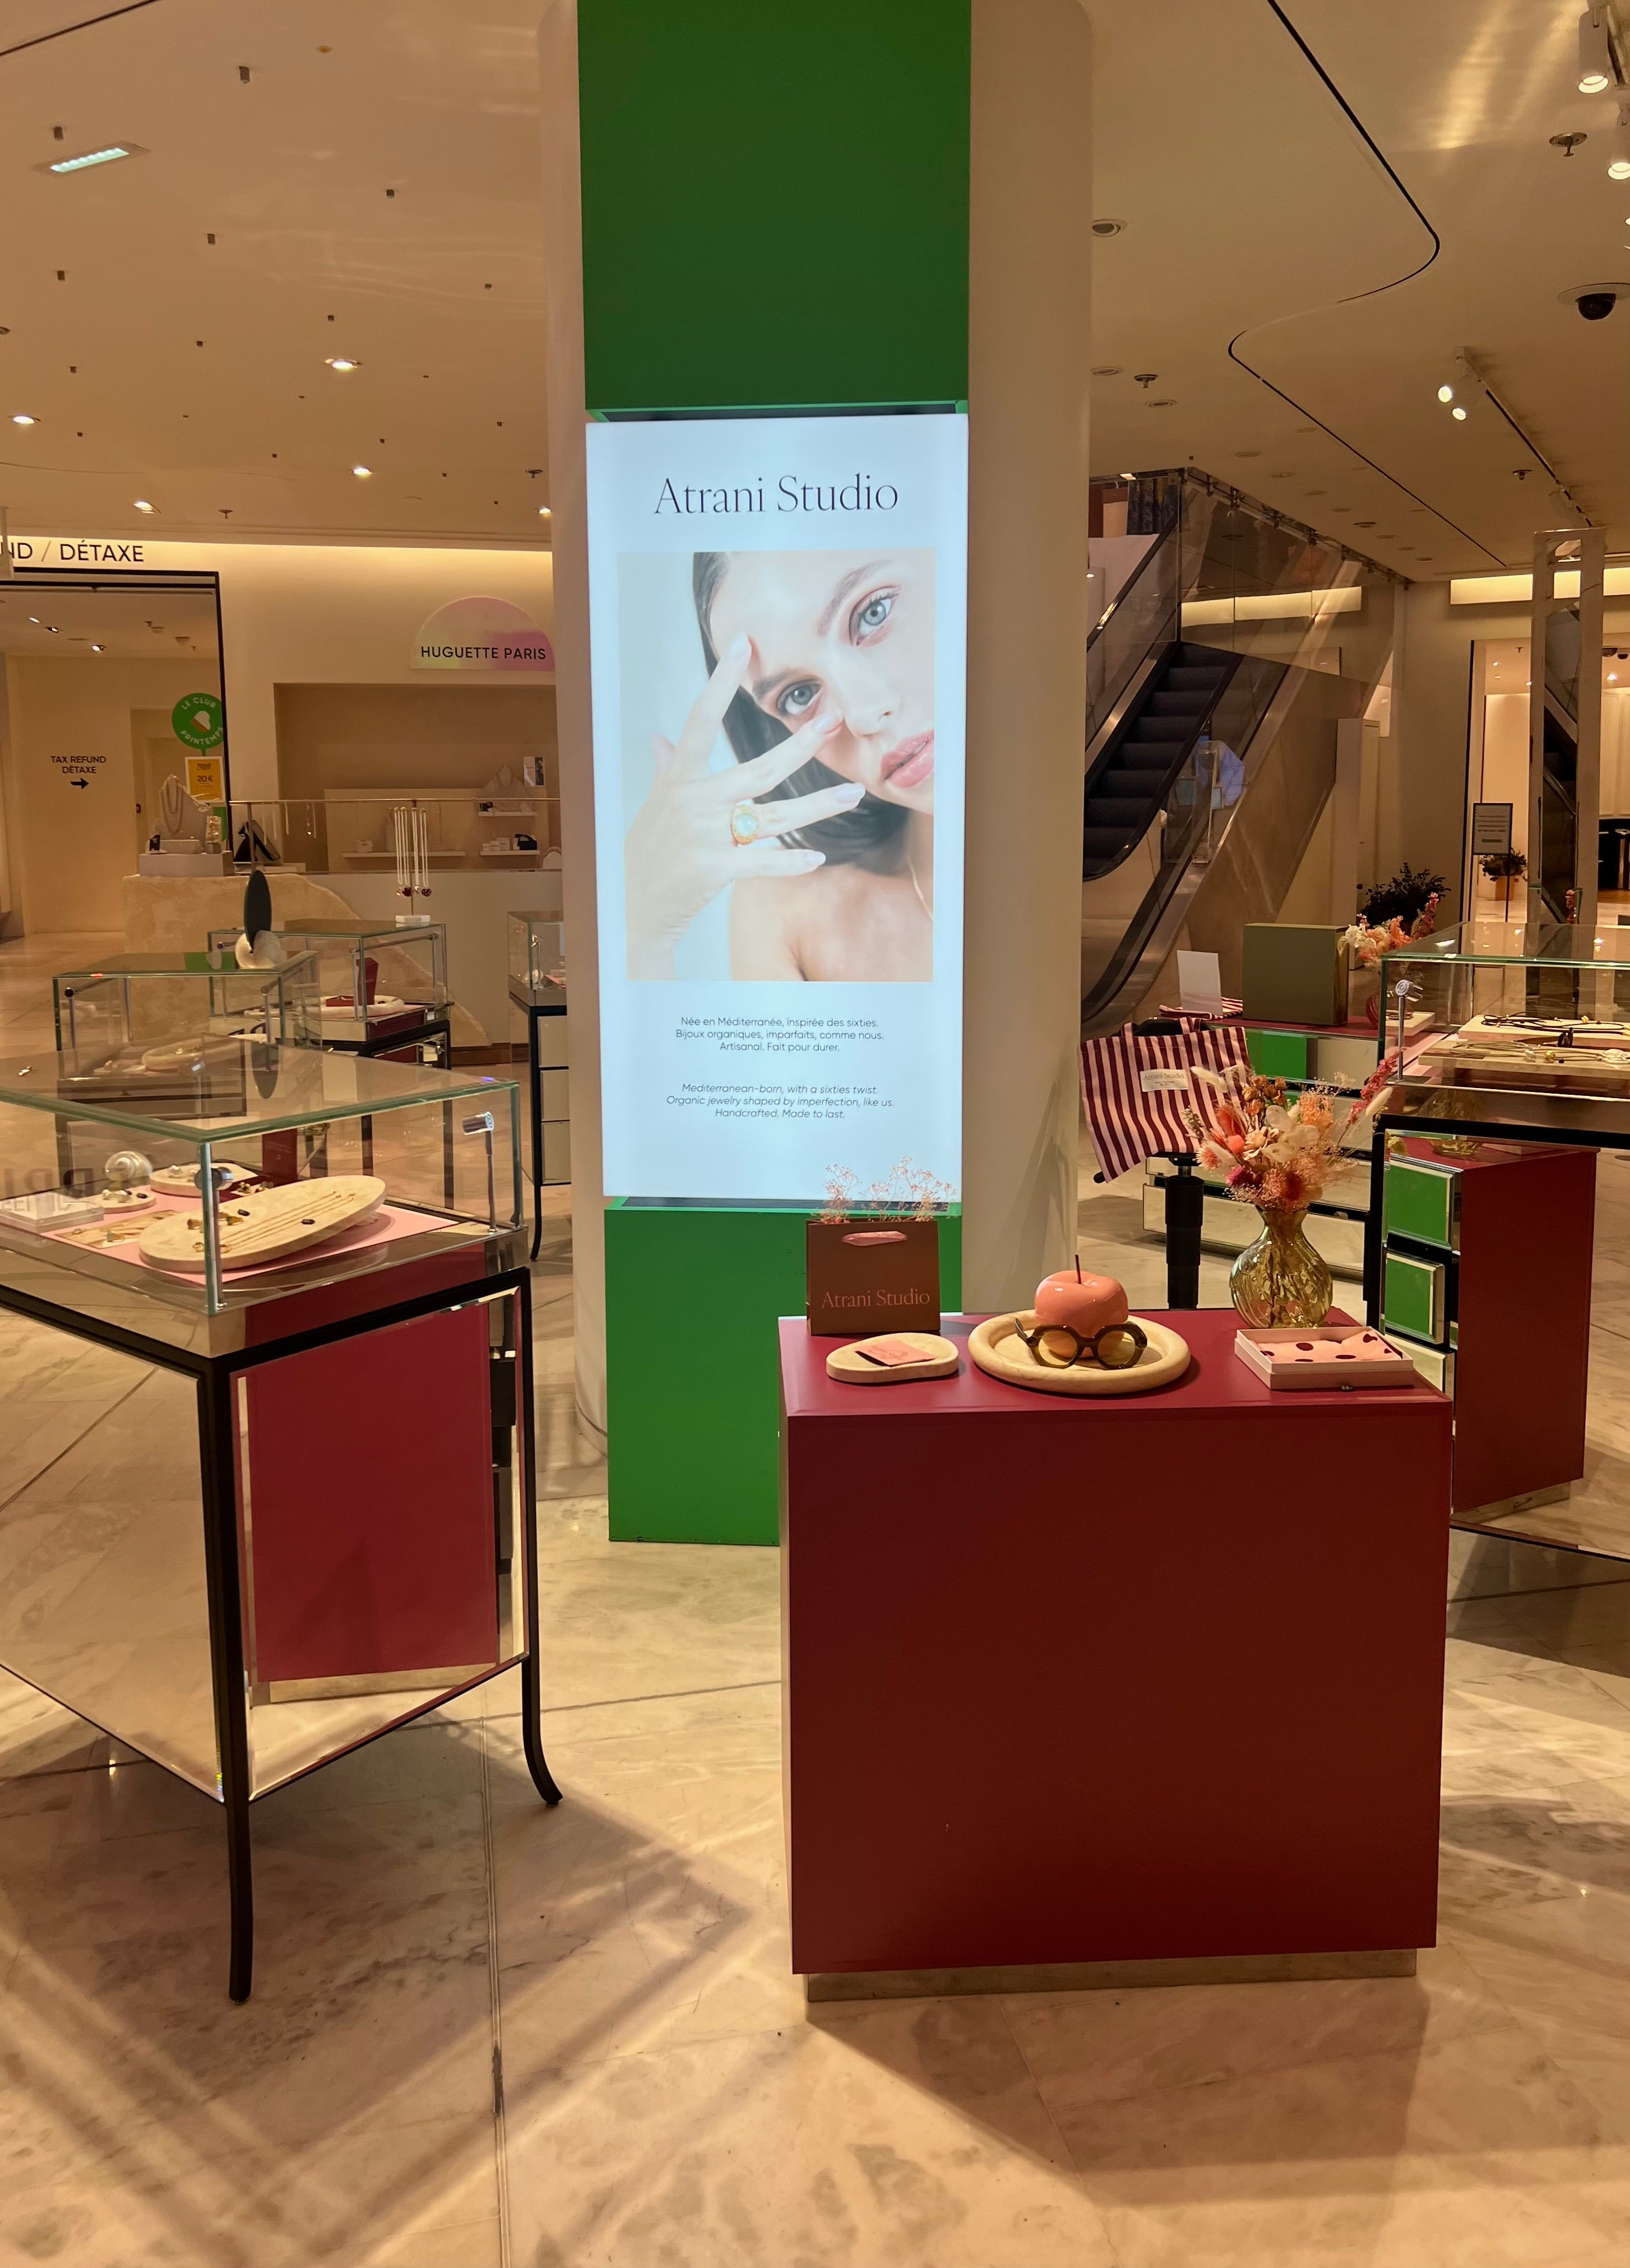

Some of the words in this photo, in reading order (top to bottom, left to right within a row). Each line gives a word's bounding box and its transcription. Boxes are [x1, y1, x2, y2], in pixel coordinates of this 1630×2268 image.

[654, 476, 766, 515] Atrani
[777, 473, 899, 512] Studio
[60, 539, 144, 562] DÉTAXE
[421, 646, 499, 659] HUGUETTE
[504, 647, 547, 660] PARIS
[181, 700, 191, 710] LE
[193, 697, 216, 708] CLUB
[180, 726, 224, 744] PRINTEMPS
[62, 765, 96, 774] DÉTAXE
[681, 1017, 701, 1026] Née
[717, 1017, 784, 1027] Méditerranée,
[786, 1018, 824, 1028] inspirée
[826, 1018, 845, 1027] des
[846, 1018, 878, 1027] sixties.
[676, 1029, 705, 1040] Bijoux
[707, 1030, 763, 1041] organiques,
[766, 1030, 817, 1041] imparfaits,
[858, 1031, 884, 1040] nous.
[720, 1042, 765, 1052] Artisanal.
[767, 1042, 786, 1051] Fait
[788, 1044, 811, 1053] pour
[812, 1043, 840, 1052] durer.
[682, 1084, 785, 1095] Mediterranean-born,
[787, 1085, 808, 1094] with
[819, 1085, 850, 1094] sixties
[853, 1085, 878, 1094] twist.
[666, 1095, 706, 1107] Organic
[706, 1096, 742, 1107] jewelry
[743, 1096, 781, 1107] shaped
[782, 1097, 796, 1107] by
[797, 1097, 861, 1108] imperfection,
[863, 1097, 879, 1107] like
[715, 1108, 780, 1118] Handcrafted.
[782, 1109, 811, 1118] Made
[813, 1109, 823, 1118] to
[825, 1109, 845, 1119] last.
[821, 1290, 871, 1308] Atrani
[876, 1288, 930, 1306] Studio
